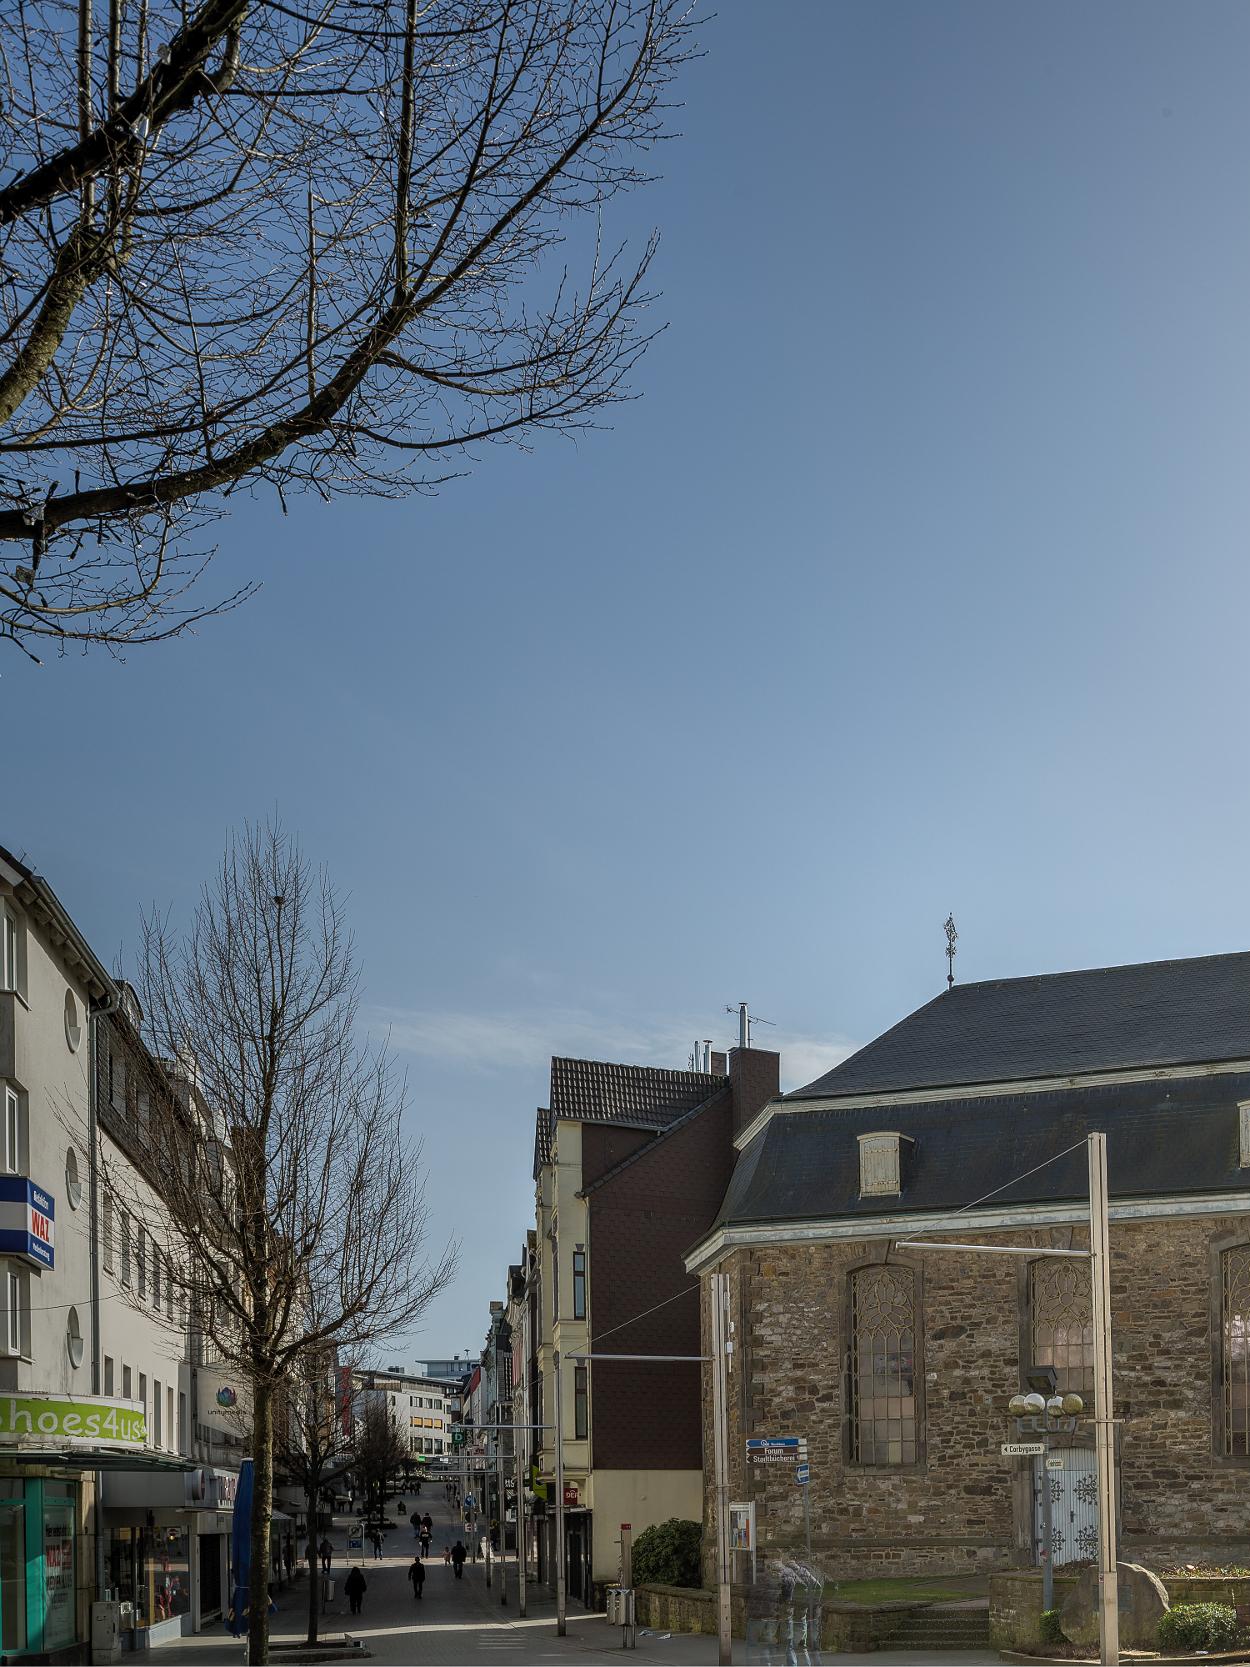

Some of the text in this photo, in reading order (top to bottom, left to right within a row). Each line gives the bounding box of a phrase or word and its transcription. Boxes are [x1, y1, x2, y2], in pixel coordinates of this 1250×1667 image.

[32, 1209, 49, 1242] WAZ
[0, 1399, 141, 1440] hoes4us
[753, 1454, 795, 1462] Stadtbücherei
